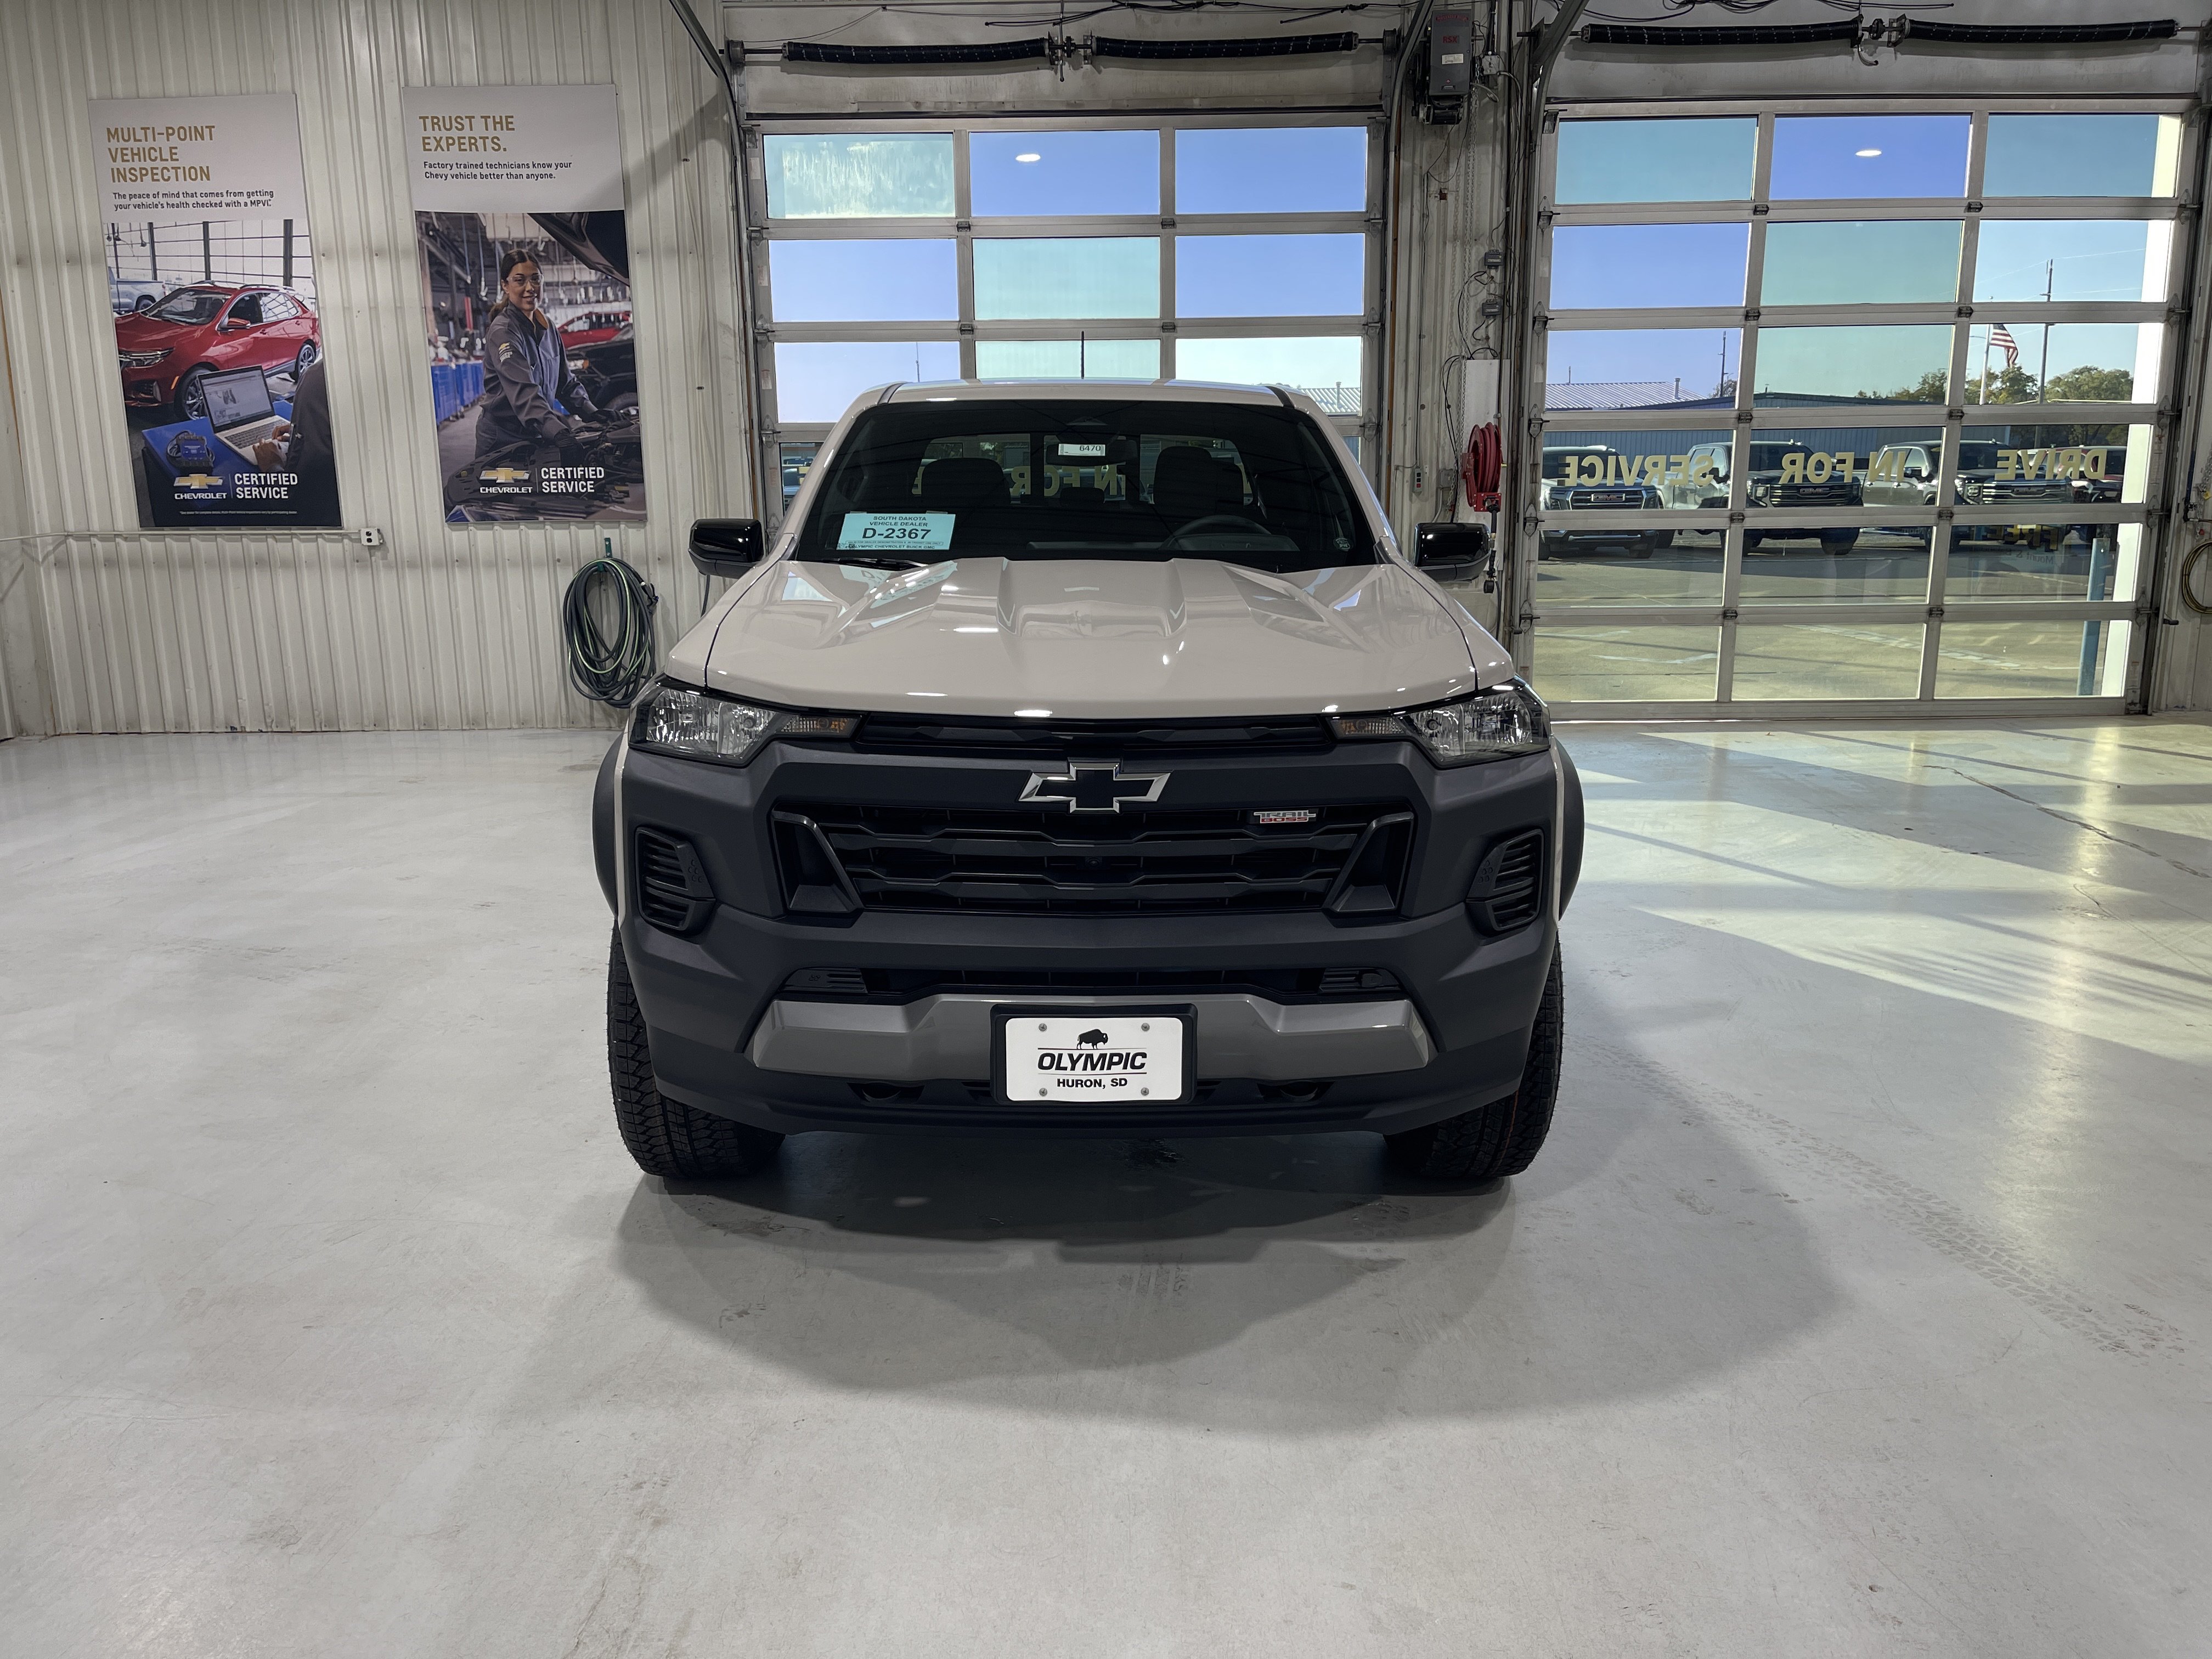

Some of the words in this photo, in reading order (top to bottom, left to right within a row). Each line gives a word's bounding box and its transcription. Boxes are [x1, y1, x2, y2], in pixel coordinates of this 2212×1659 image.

[419, 115, 476, 132] TRUST
[481, 115, 515, 131] THE
[106, 126, 216, 143] MULTI-POINT
[421, 136, 507, 152] EXPERTS.
[108, 146, 179, 163] VEHICLE
[424, 161, 454, 170] Factory
[554, 162, 572, 170] your
[111, 166, 211, 183] INSPECTION
[425, 171, 448, 180] Chevy
[526, 172, 556, 180] anyone.
[246, 189, 274, 199] getting
[132, 201, 165, 210] vehicle's
[166, 201, 190, 209] health
[234, 473, 298, 485] CERTIFIED
[541, 467, 604, 479] CERTIFIED
[236, 487, 289, 499] SERVICE
[542, 481, 595, 493] SERVICE
[862, 528, 932, 539] D-2367
[1037, 1052, 1147, 1071] OLYMPIC
[1057, 1079, 1106, 1089] HURON,
[1110, 1078, 1128, 1087] SD
